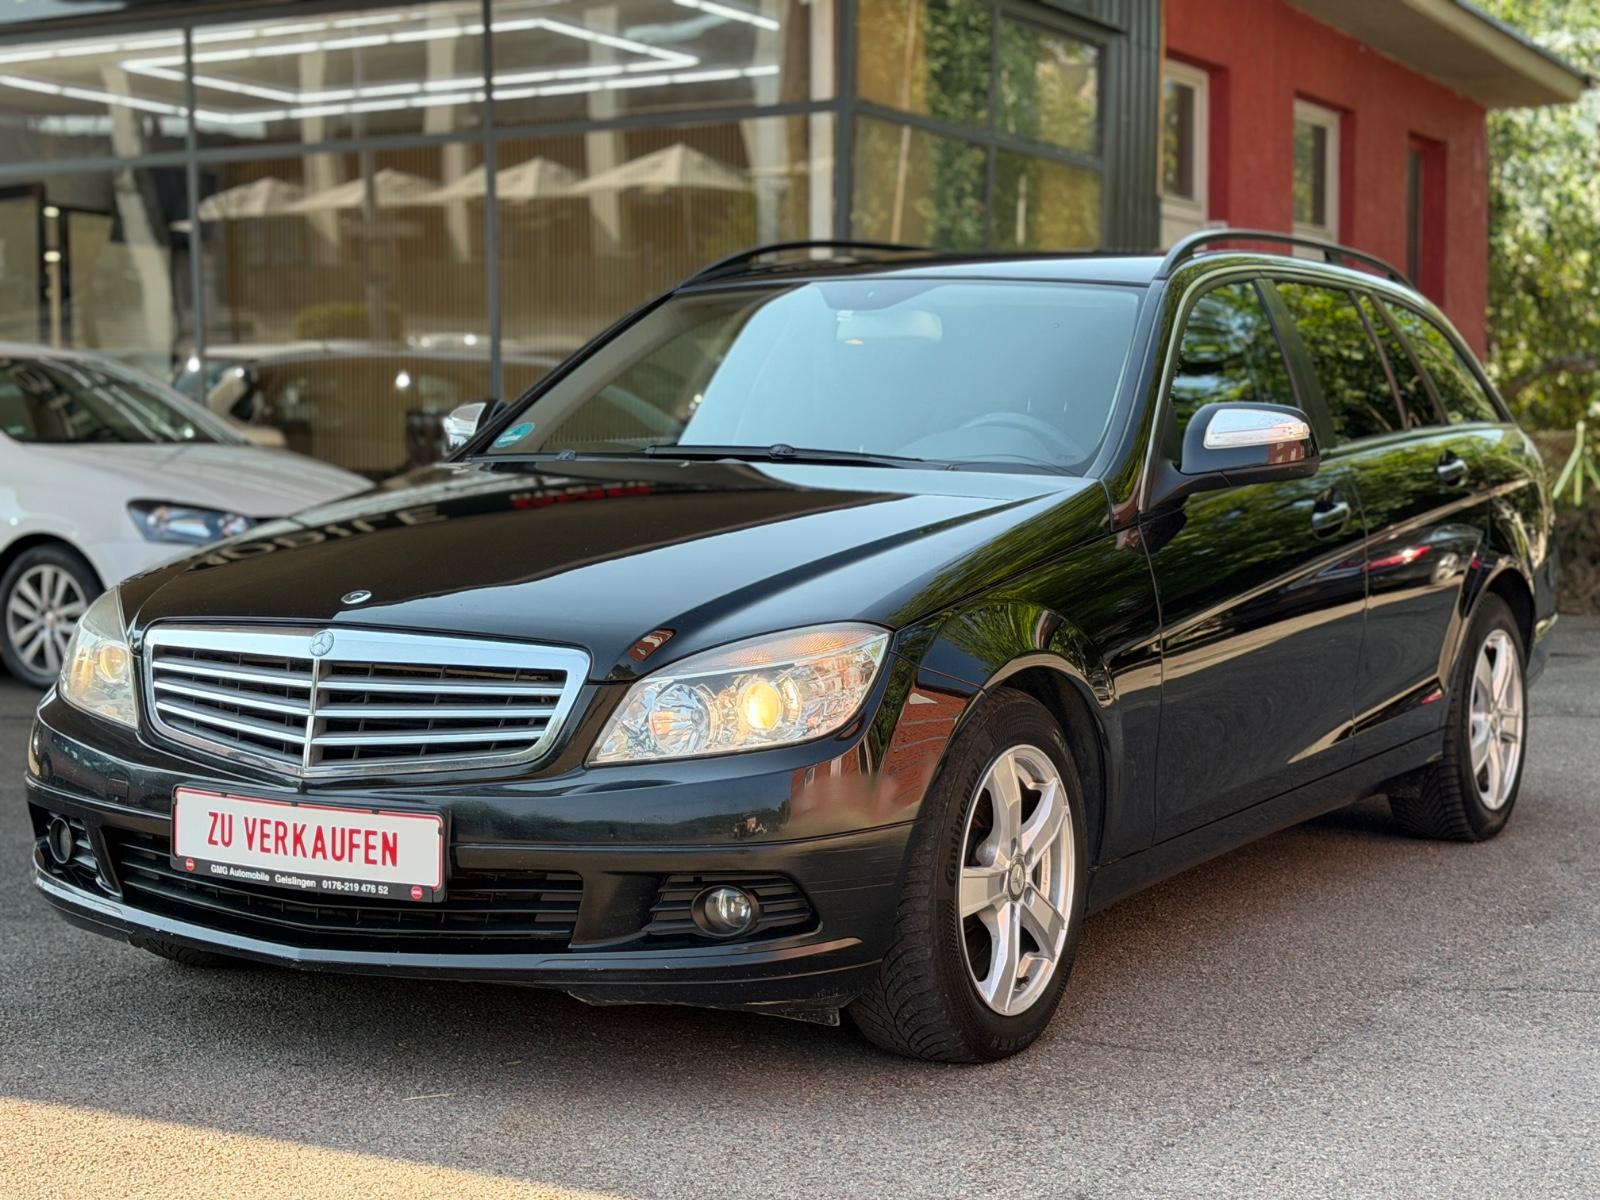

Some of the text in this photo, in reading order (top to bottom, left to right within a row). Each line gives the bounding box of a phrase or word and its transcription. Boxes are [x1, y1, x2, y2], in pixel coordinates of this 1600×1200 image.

[207, 811, 398, 867] ZU VERKAUFEN
[945, 759, 981, 887] Continental
[210, 864, 389, 895] GMG Automobile Geislingen 0176-219 476 52
